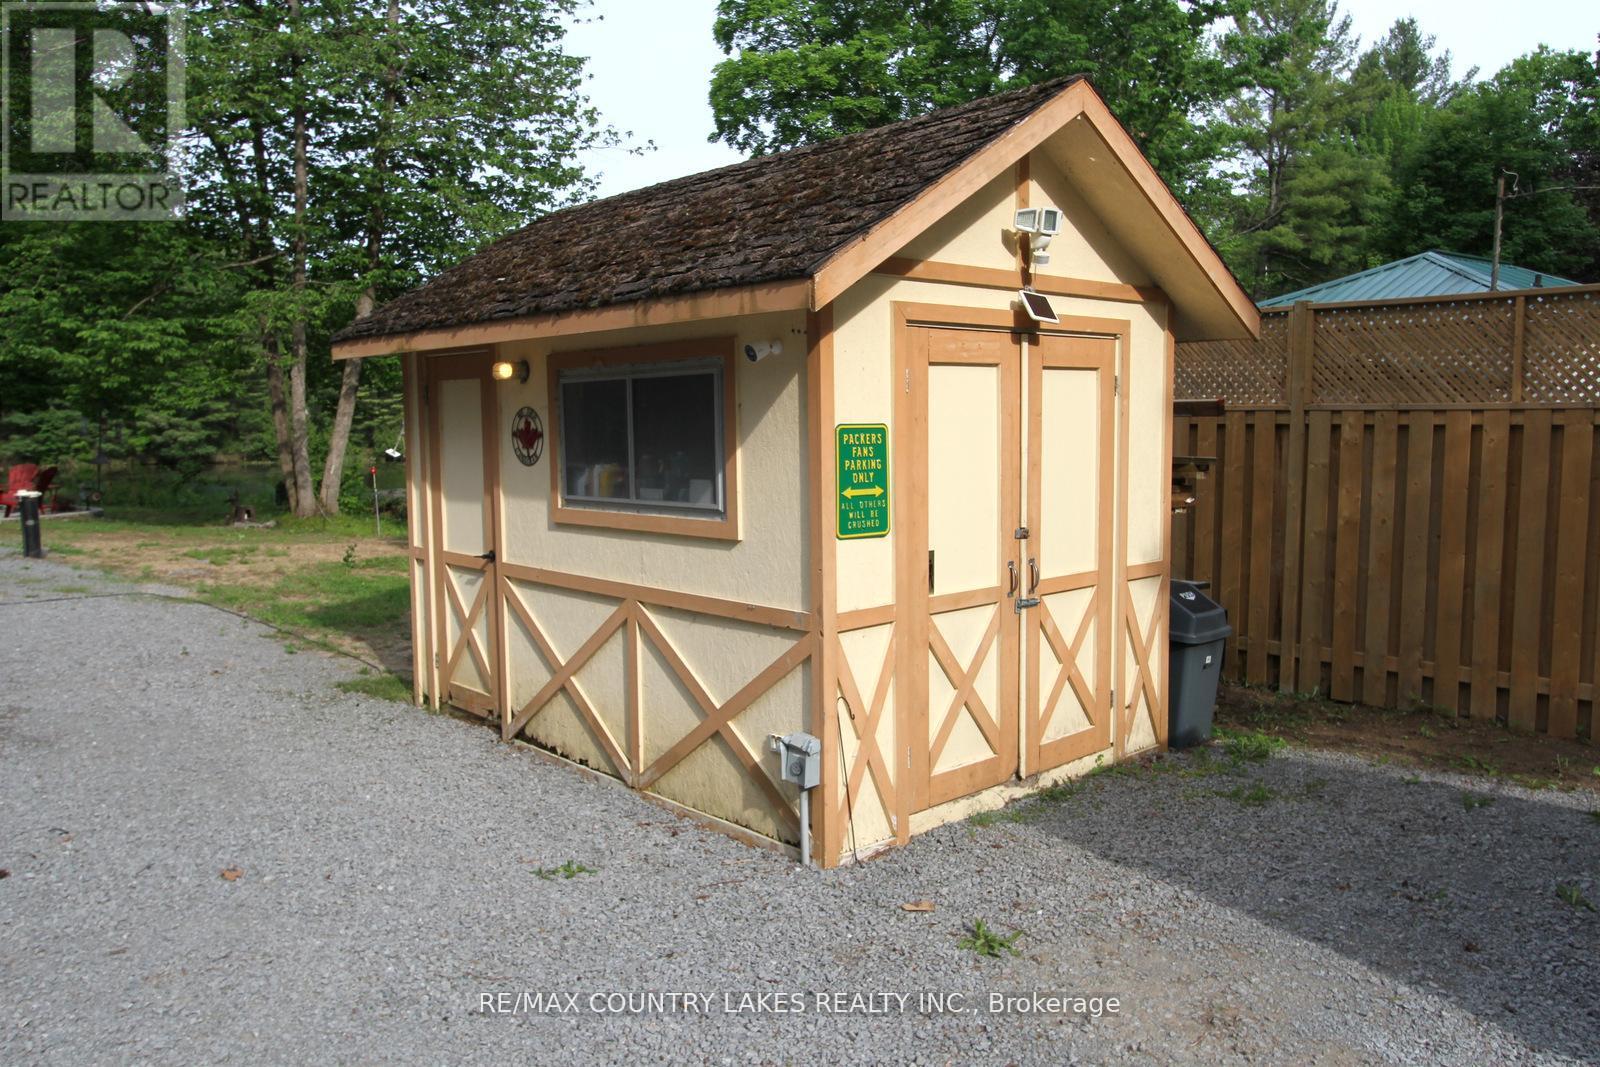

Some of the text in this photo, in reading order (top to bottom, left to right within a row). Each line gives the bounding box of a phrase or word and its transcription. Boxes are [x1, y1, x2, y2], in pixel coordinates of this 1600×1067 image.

[843, 433, 882, 444] PACKERS
[852, 446, 874, 457] FANS
[844, 459, 882, 470] PARKING
[852, 472, 875, 483] ONLY
[841, 499, 886, 510] ALL OTHERS
[848, 510, 879, 519] WILL BE
[847, 519, 880, 529] CRUSHED
